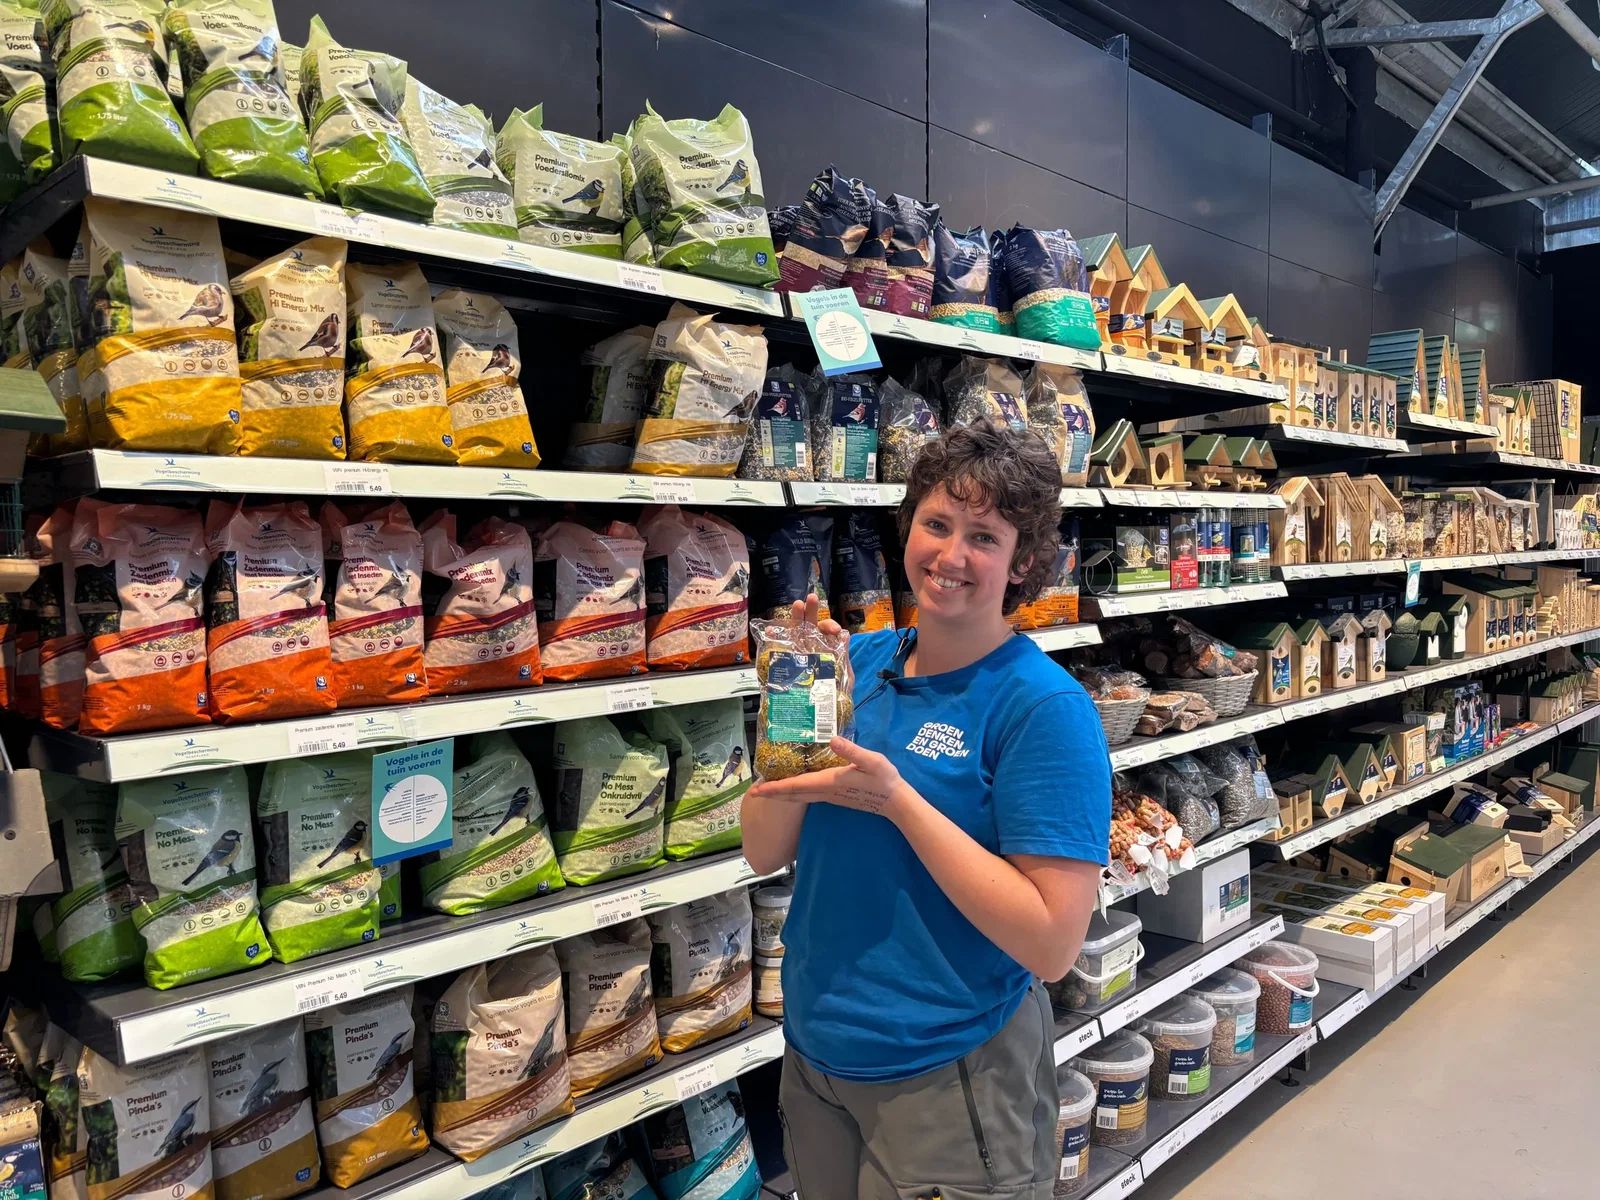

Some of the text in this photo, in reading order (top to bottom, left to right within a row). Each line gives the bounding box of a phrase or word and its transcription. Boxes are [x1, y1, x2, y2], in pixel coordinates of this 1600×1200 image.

[535, 154, 568, 168] Premium
[534, 162, 586, 182] Voedersilomix
[136, 260, 176, 274] Premium
[269, 289, 304, 303] Premium
[806, 293, 830, 304] Vogels
[270, 300, 280, 309] Hi
[281, 302, 308, 313] Energy
[702, 370, 732, 384] Premium
[709, 380, 732, 395] Energy
[733, 385, 744, 395] Mix
[128, 561, 168, 572] Premium
[244, 557, 278, 565] Premium
[576, 562, 609, 573] Premium
[686, 556, 710, 568] Premium
[244, 565, 284, 573] Zadenmix
[577, 570, 614, 582] Zadenmix
[924, 722, 964, 739] GROEN
[918, 728, 964, 749] DENKEN
[174, 747, 219, 757] Vogelbescherming
[906, 743, 940, 760] DOEN
[912, 737, 969, 757] EN GROEN
[386, 747, 443, 767] Vogels in de
[387, 758, 441, 776] tuin voeren
[602, 772, 637, 782] Premium
[602, 782, 634, 791] No Mess
[600, 791, 642, 800] Onkruidvrij
[301, 812, 334, 821] Premium
[301, 821, 334, 831] No Mess
[157, 834, 196, 849] No Mess
[688, 938, 710, 949] Premium
[308, 978, 326, 986] Premium
[589, 971, 623, 982] Premium
[589, 981, 618, 991] Pinda's
[334, 992, 347, 1001] 5,49
[345, 1022, 378, 1036] Premium
[486, 1027, 522, 1042] Premium
[346, 1033, 374, 1044] Pinda's
[211, 1051, 246, 1069] Premium
[212, 1063, 242, 1079] Pinda's
[127, 1089, 167, 1107] Premium
[128, 1102, 162, 1117] Pinda's
